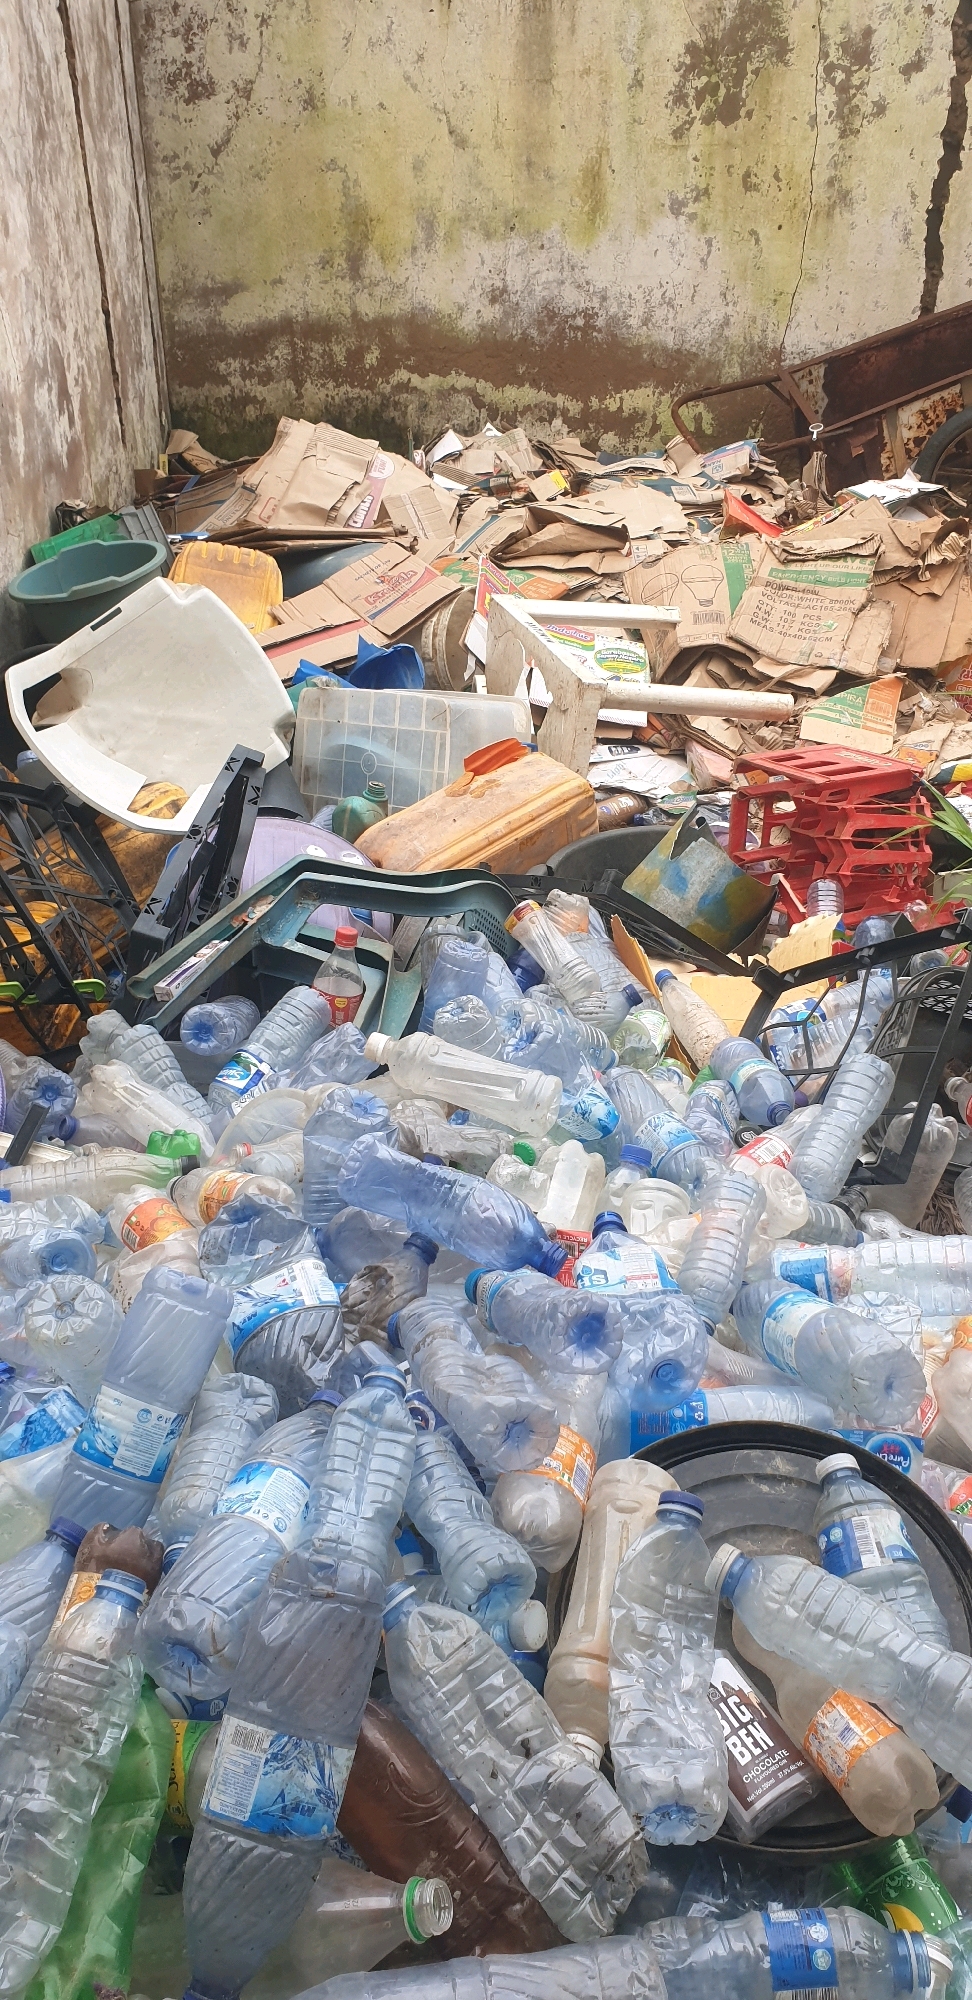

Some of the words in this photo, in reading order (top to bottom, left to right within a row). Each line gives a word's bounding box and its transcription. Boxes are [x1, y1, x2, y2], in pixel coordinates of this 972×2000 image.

[803, 613, 822, 621] PCS
[726, 1721, 775, 1767] BEN
[742, 1748, 790, 1783] CHOCOLATE
[754, 1763, 779, 1784] FLAVOURED
